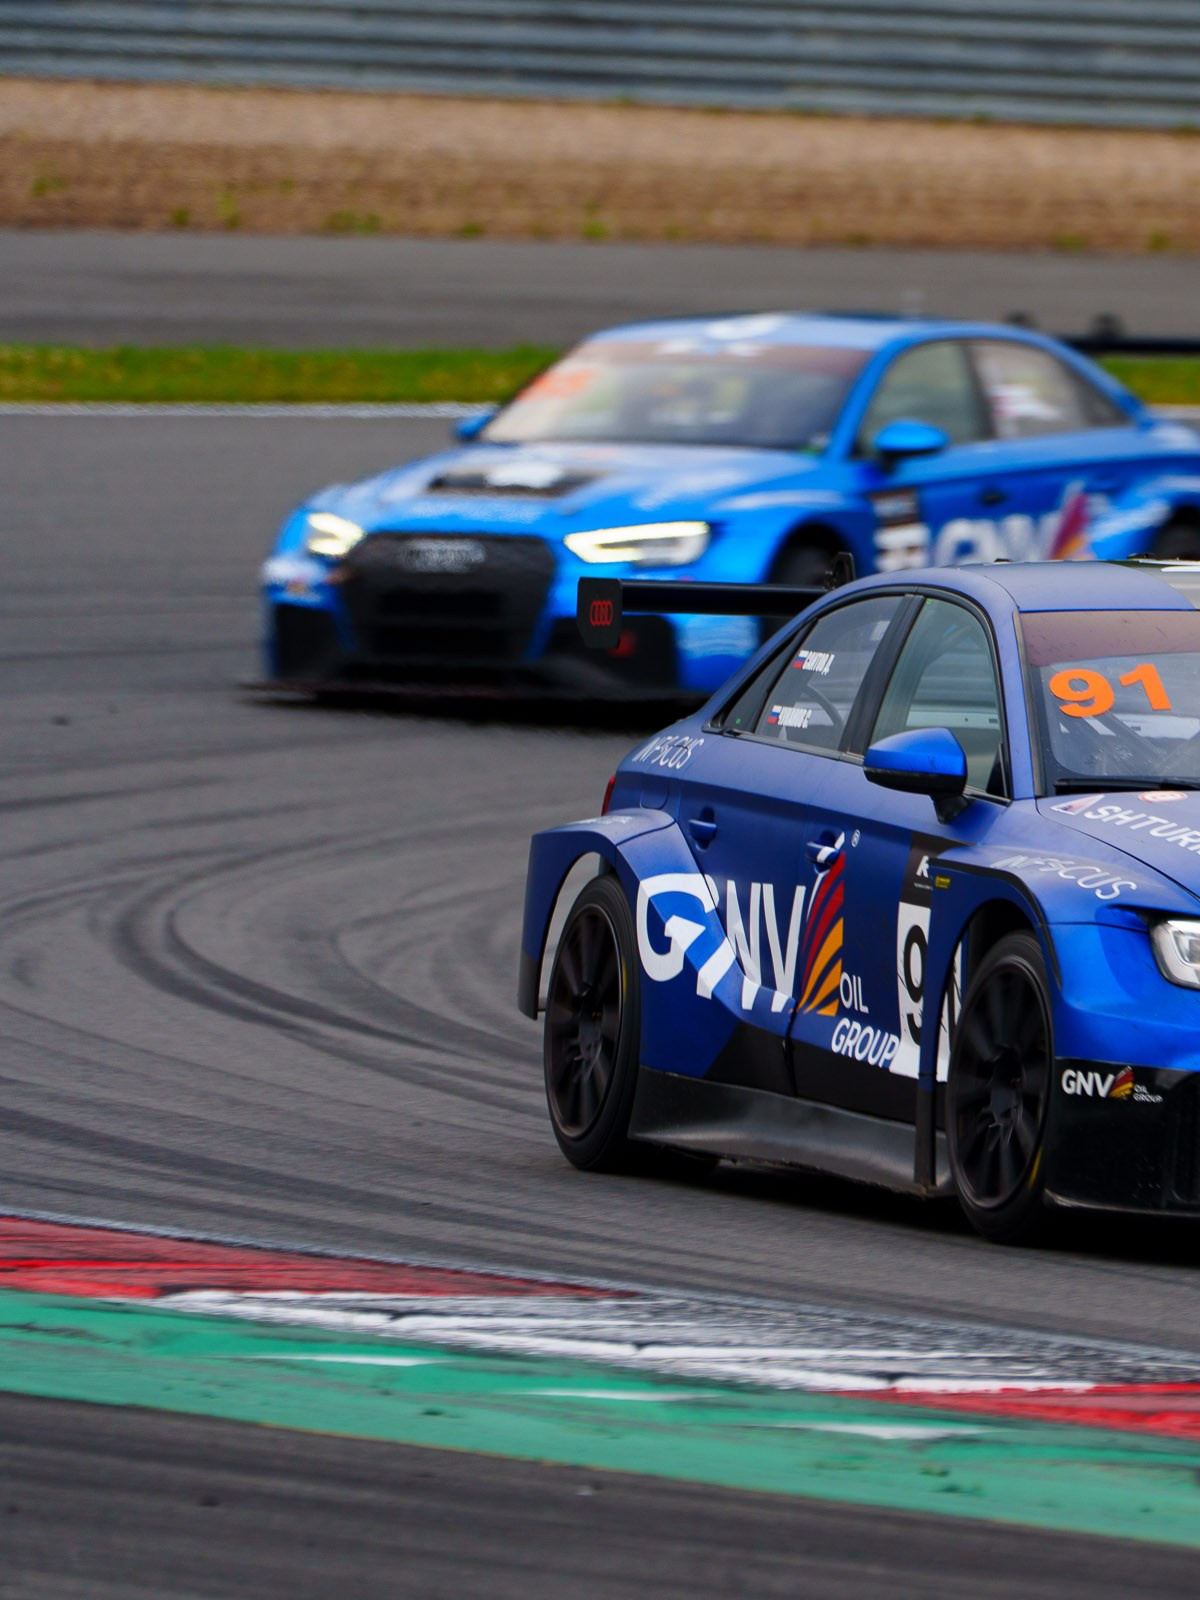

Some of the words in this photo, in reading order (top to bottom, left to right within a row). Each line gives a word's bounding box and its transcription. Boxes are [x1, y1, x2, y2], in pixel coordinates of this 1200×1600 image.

[1048, 664, 1172, 718] 91
[636, 873, 807, 1013] GNV
[839, 971, 869, 1013] OIL
[831, 1018, 900, 1068] GROUP
[1061, 1069, 1115, 1098] GNV
